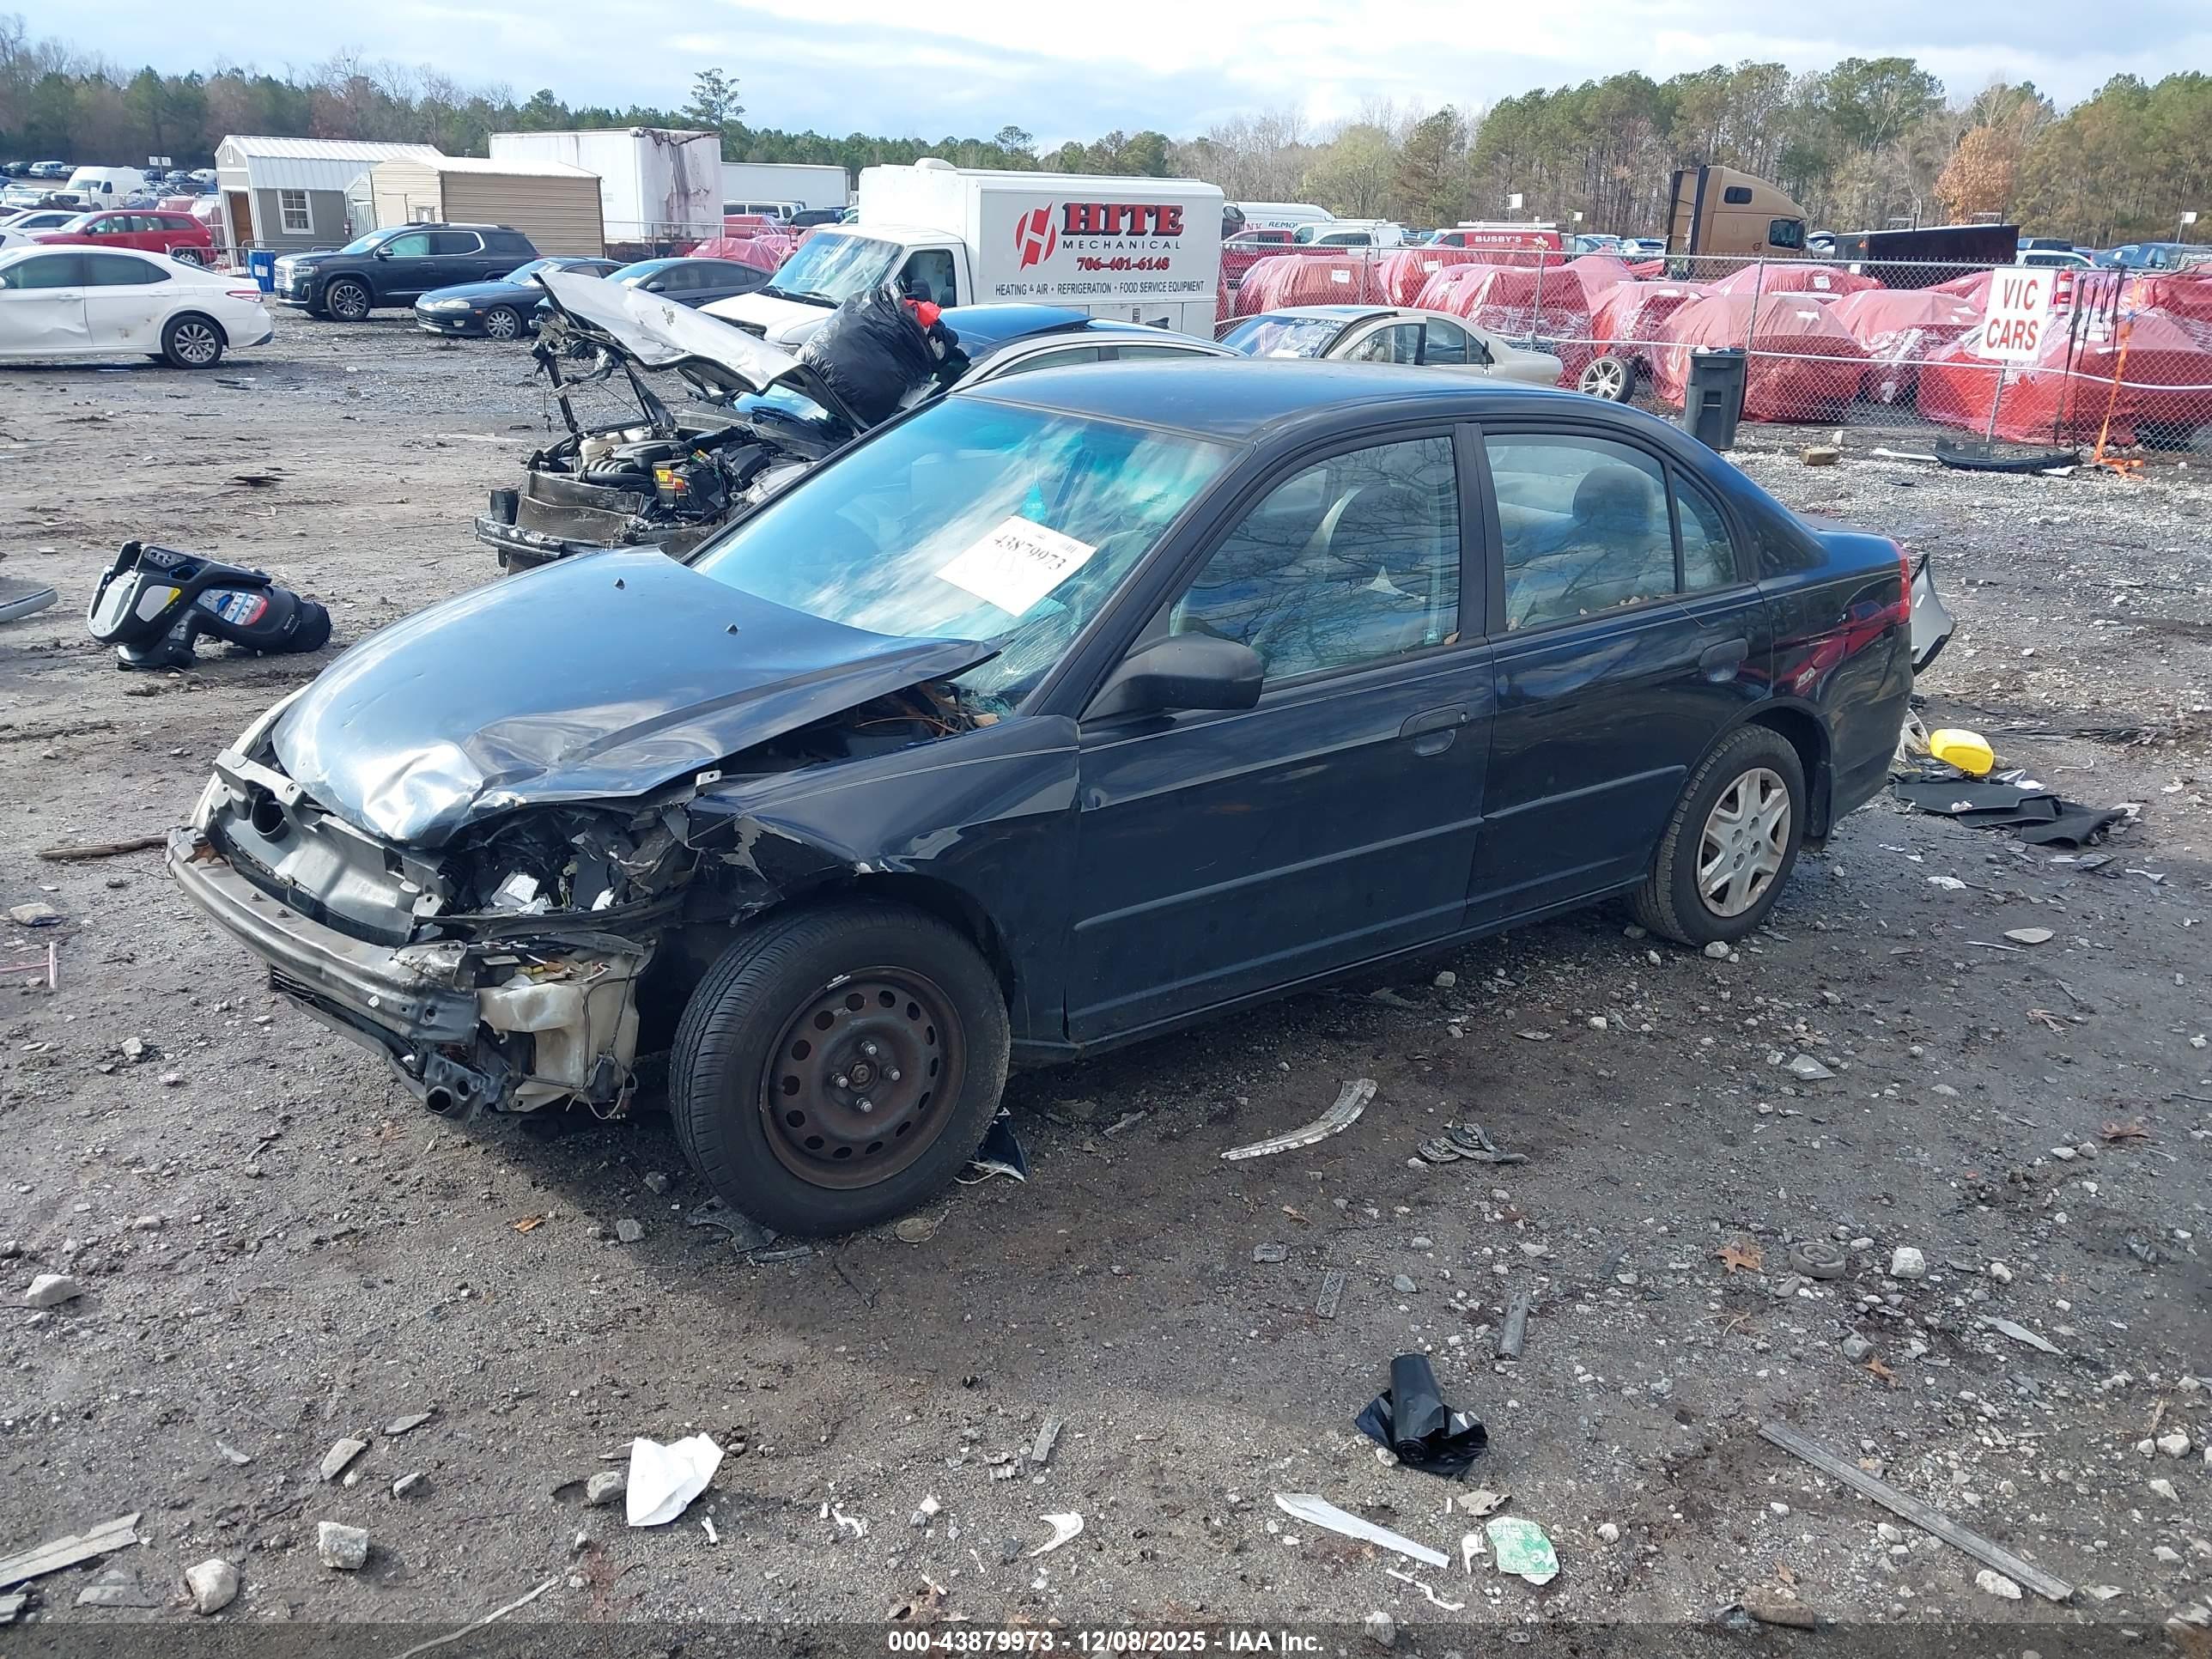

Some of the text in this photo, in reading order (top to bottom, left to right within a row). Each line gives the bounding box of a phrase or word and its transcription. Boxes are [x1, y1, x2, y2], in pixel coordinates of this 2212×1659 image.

[1061, 202, 1184, 236] HITE
[1062, 240, 1181, 250] MECHANICAL
[1076, 257, 1170, 270] 706-401-6148
[995, 283, 1027, 296] HEATING
[1036, 283, 1048, 295] AIR
[1057, 283, 1112, 295] REFRIGERATION
[1119, 282, 1139, 294] FOOD
[1139, 282, 1167, 293] SERVICE
[1168, 280, 1205, 292] EQUIPMENT
[2003, 279, 2039, 310] VIC
[1986, 318, 2039, 350] CARS
